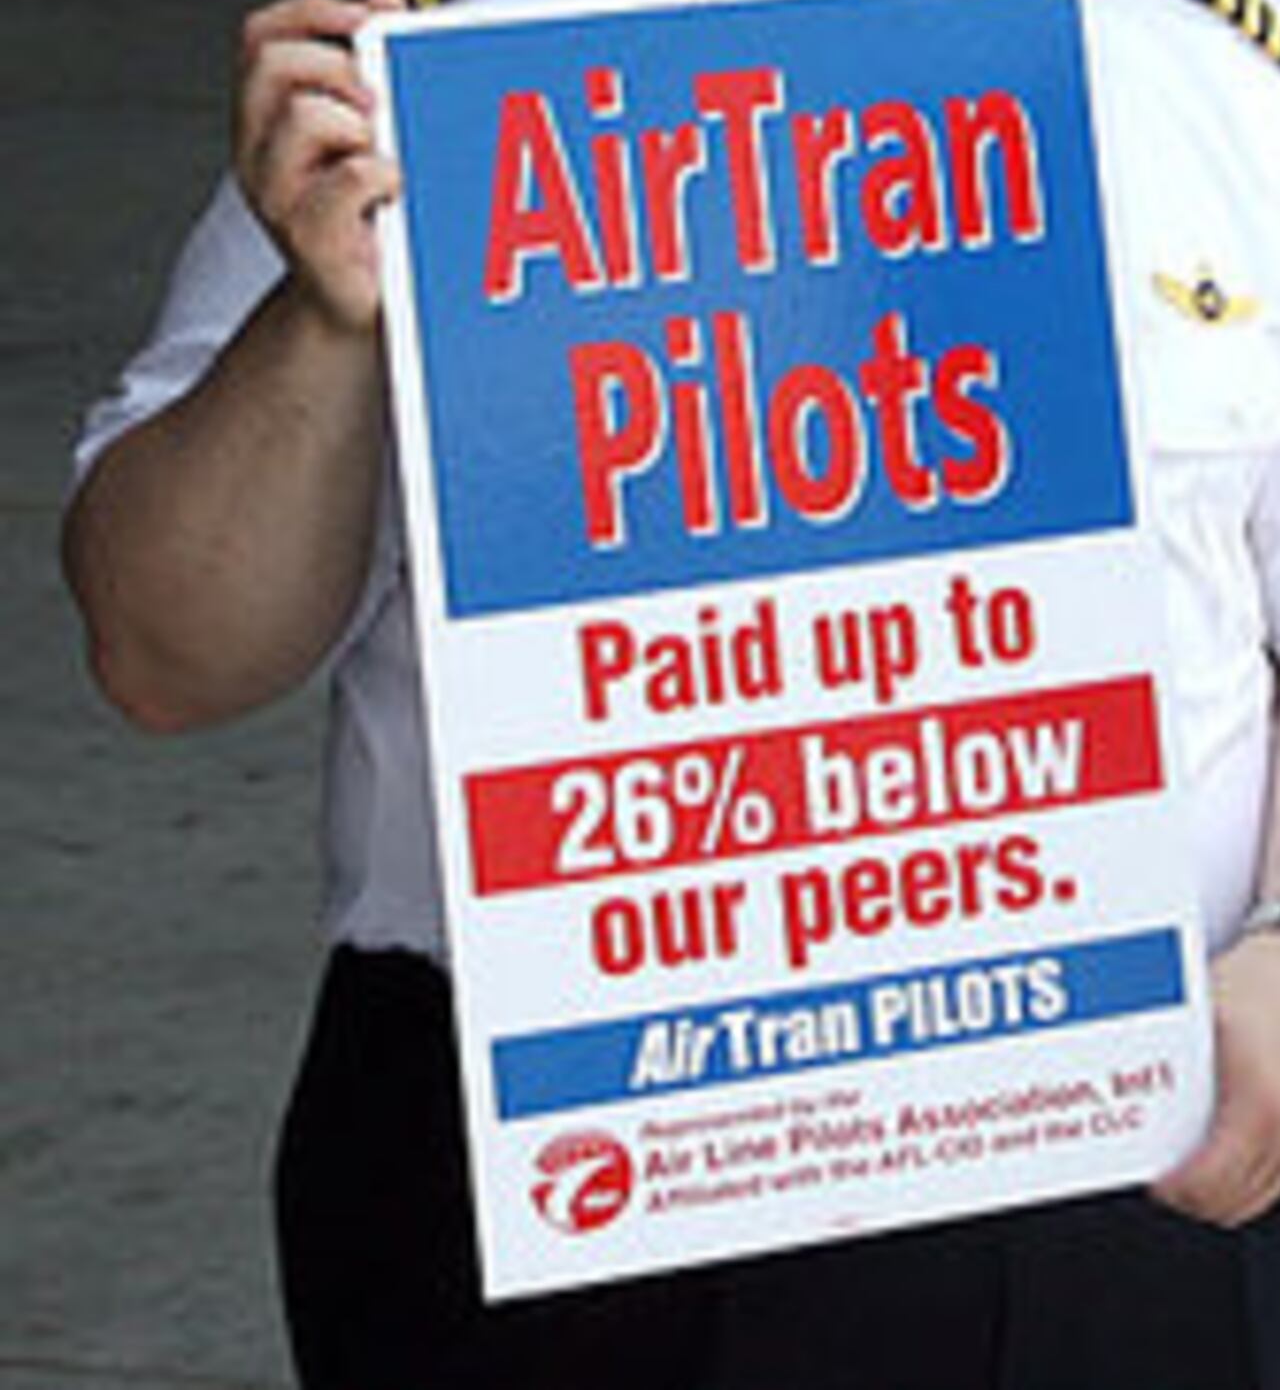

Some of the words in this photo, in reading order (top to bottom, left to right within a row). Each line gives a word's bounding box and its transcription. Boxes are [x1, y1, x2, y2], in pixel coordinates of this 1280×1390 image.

[483, 67, 1045, 304] AirTran
[567, 310, 1010, 547] Pilots
[578, 598, 783, 722] Paid
[812, 600, 920, 704] up
[946, 574, 1036, 668] to
[551, 750, 775, 875] 26%
[804, 717, 1084, 836] below
[590, 875, 747, 977] our
[780, 833, 1077, 969] peers.
[630, 1002, 862, 1091] AirTran
[870, 956, 1069, 1046] PILOTS
[644, 1148, 692, 1182] Air
[704, 1135, 777, 1172] Line
[787, 1118, 886, 1158] Pilots
